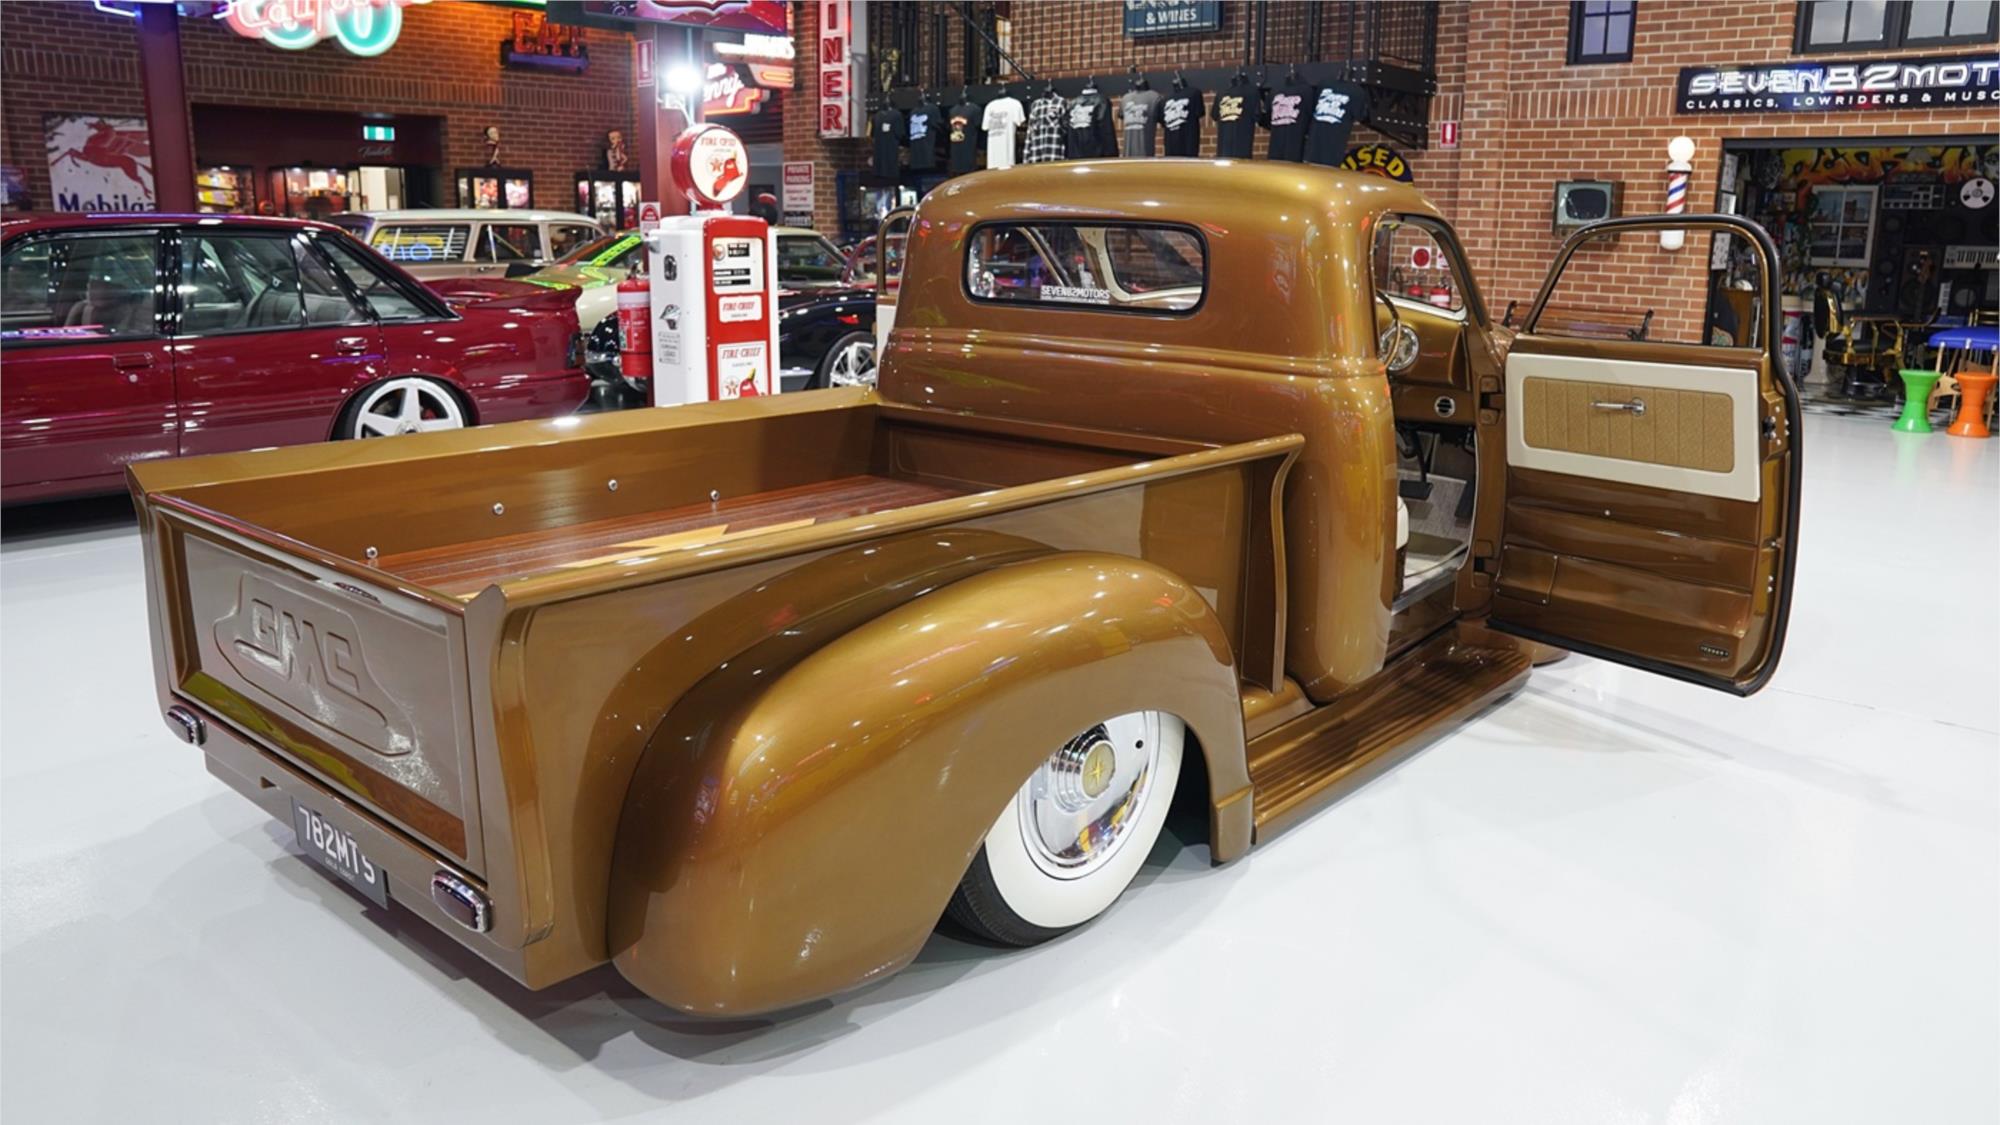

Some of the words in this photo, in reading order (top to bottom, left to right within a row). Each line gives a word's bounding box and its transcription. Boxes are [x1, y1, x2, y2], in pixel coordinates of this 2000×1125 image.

[1145, 12, 1156, 25] &
[1158, 8, 1198, 23] WINES
[1686, 98, 1779, 110] CLASSICS,
[1793, 94, 1909, 107] LOWRIDERS
[1921, 92, 1932, 103] &
[1341, 147, 1405, 177] USED
[723, 302, 737, 312] FIRE
[738, 301, 755, 311] CHIEF
[722, 348, 739, 360] FIRE
[740, 346, 762, 358] CHIEF
[249, 597, 361, 694] GMC
[298, 806, 375, 885] 782MTS
